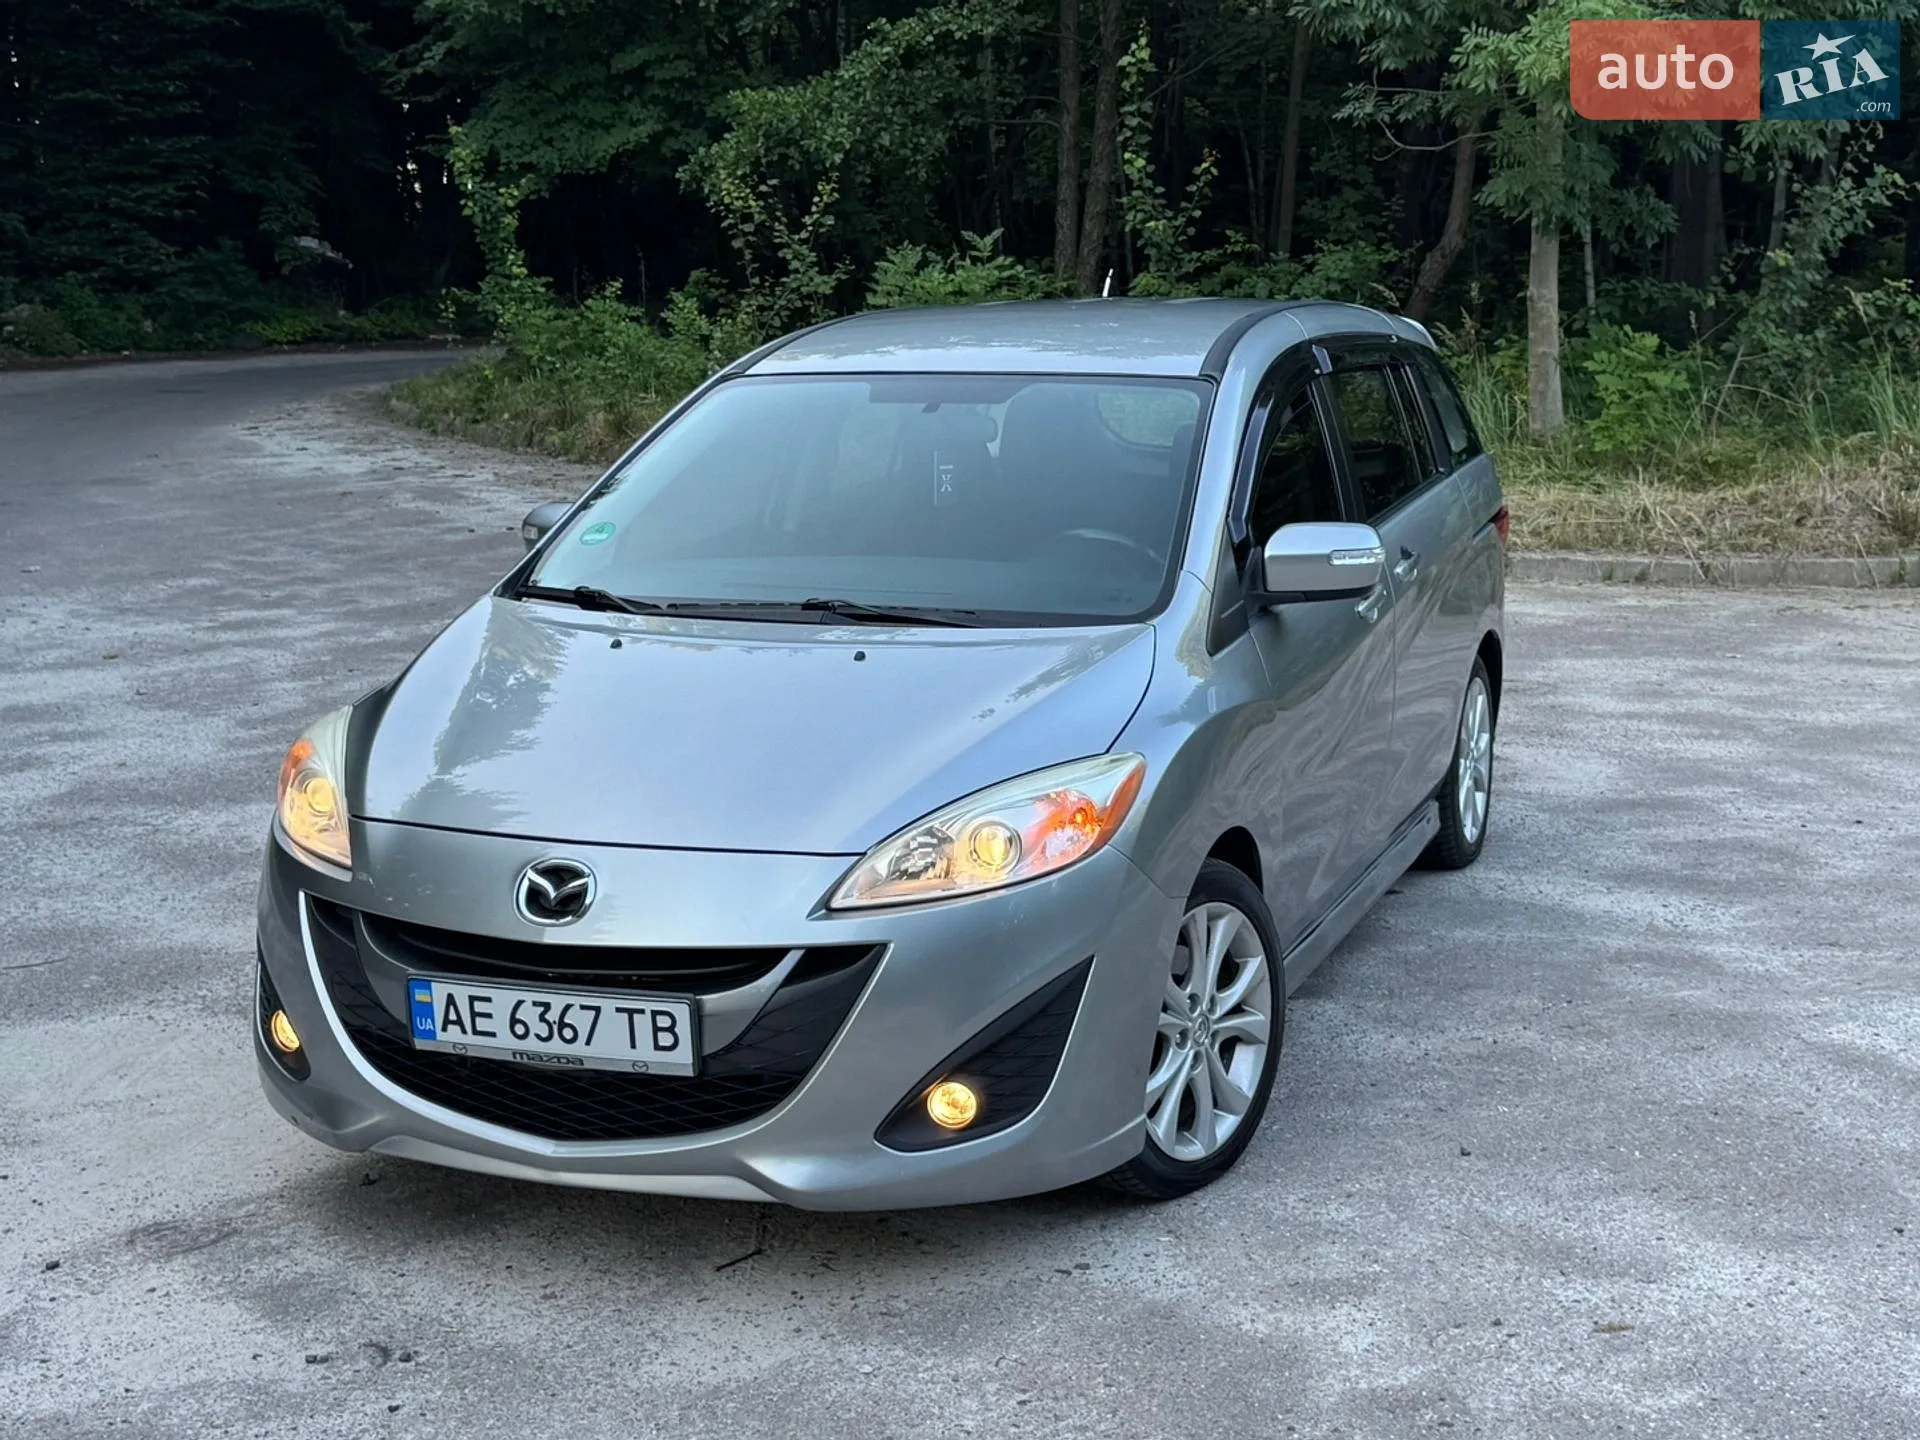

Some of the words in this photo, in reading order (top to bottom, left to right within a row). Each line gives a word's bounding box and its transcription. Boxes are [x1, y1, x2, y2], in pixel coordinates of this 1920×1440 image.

[416, 1015, 435, 1031] UA
[440, 992, 497, 1038] AE
[508, 999, 602, 1046] 6367
[614, 1006, 680, 1052] TB
